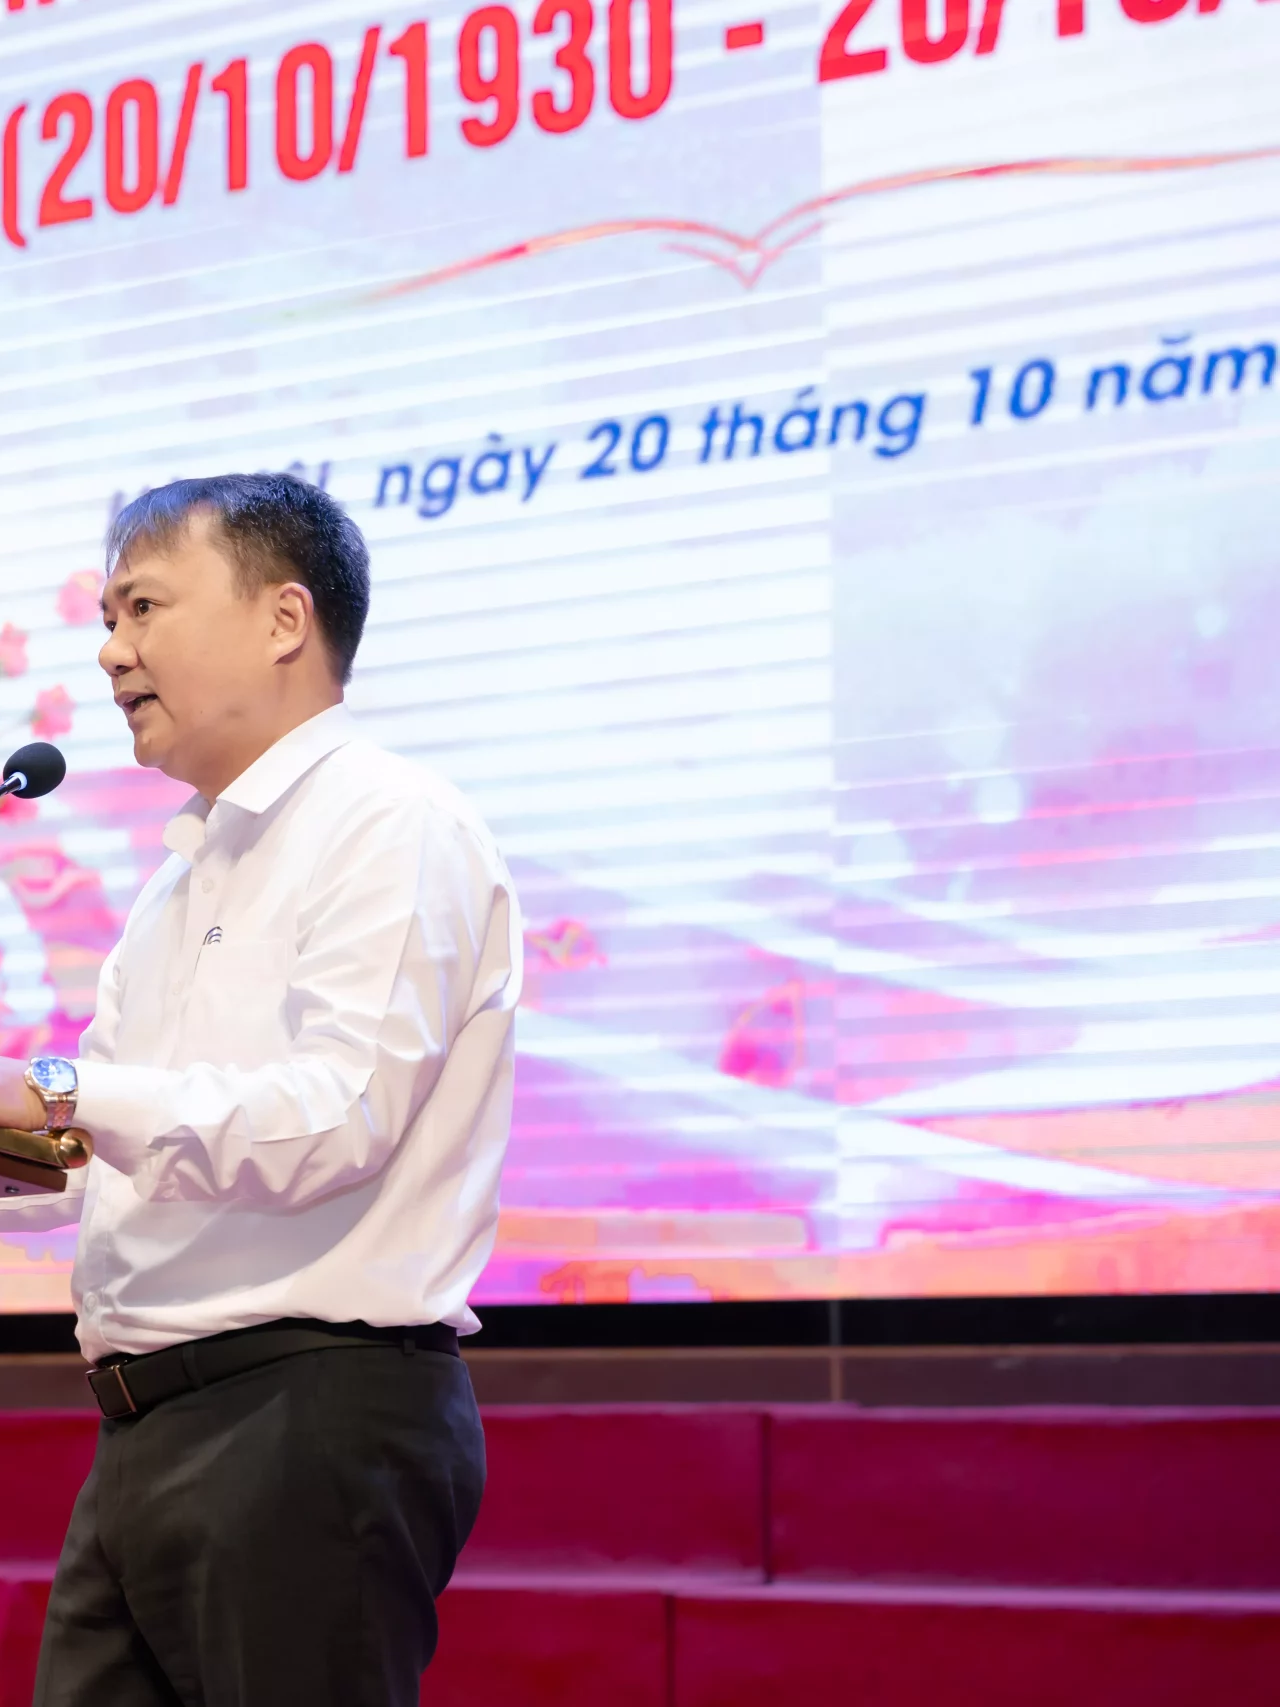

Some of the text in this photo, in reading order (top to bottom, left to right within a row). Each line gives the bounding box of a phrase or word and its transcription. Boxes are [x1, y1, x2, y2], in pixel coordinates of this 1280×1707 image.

[1, 0, 673, 249] (20/10/1930
[725, 22, 764, 50] -
[373, 431, 558, 520] ngày
[579, 411, 672, 481] 20
[697, 385, 927, 460] tháng
[969, 355, 1058, 427] 10
[1083, 331, 1278, 411] năm
